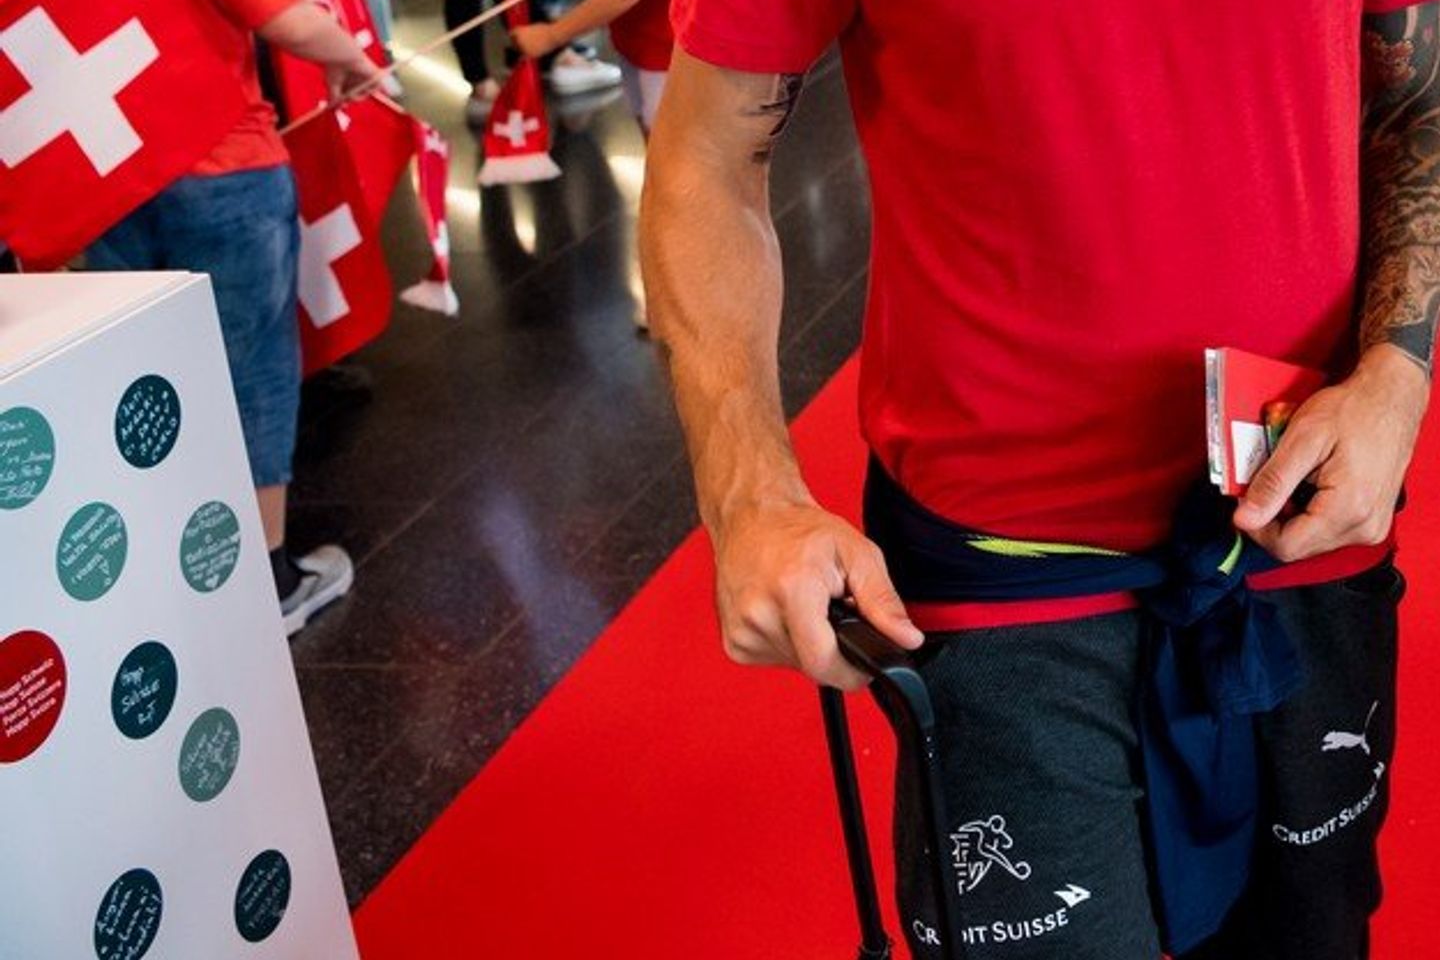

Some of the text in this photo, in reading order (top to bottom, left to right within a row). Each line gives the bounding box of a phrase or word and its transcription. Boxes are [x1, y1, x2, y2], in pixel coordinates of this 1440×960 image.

[1271, 817, 1338, 846] CREDIT
[912, 908, 1070, 945] CRIT SUISSE
